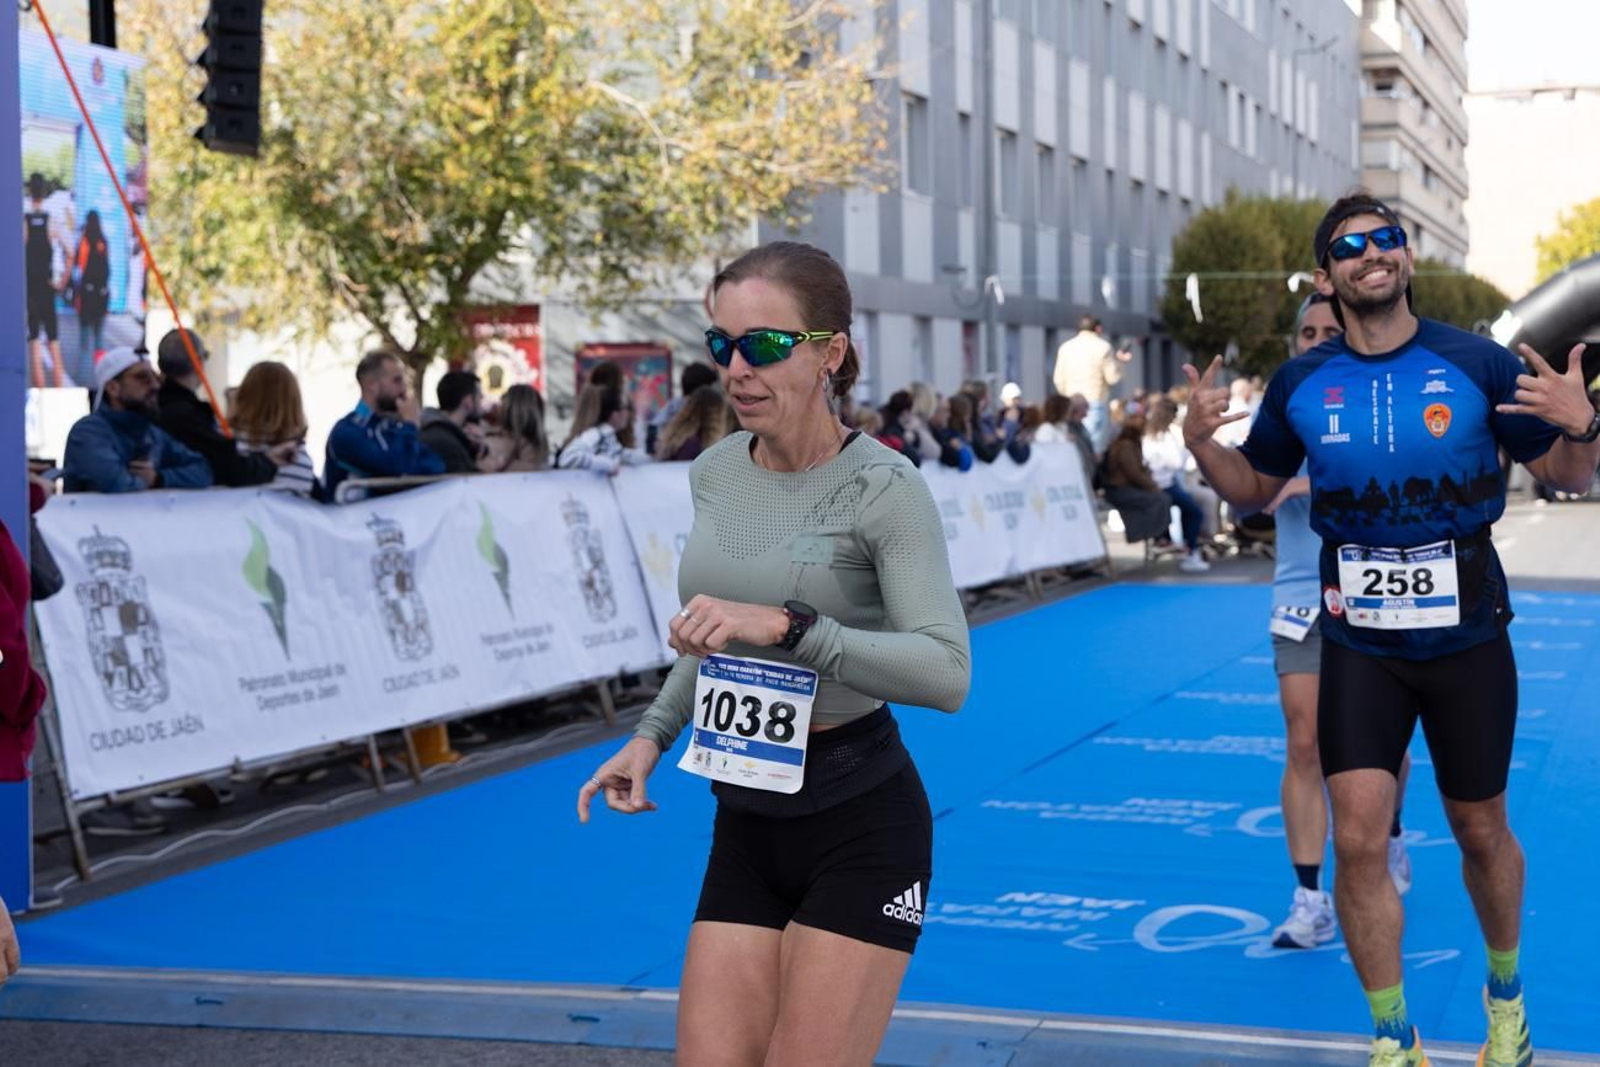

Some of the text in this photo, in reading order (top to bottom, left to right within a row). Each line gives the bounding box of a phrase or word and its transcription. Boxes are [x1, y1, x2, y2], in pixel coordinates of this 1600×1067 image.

[1329, 413, 1339, 434] II
[1362, 567, 1435, 596] 258
[701, 687, 797, 744] 1038
[89, 724, 146, 751] CIUDAD
[146, 719, 167, 742] DE
[716, 735, 749, 751] DELPHINE
